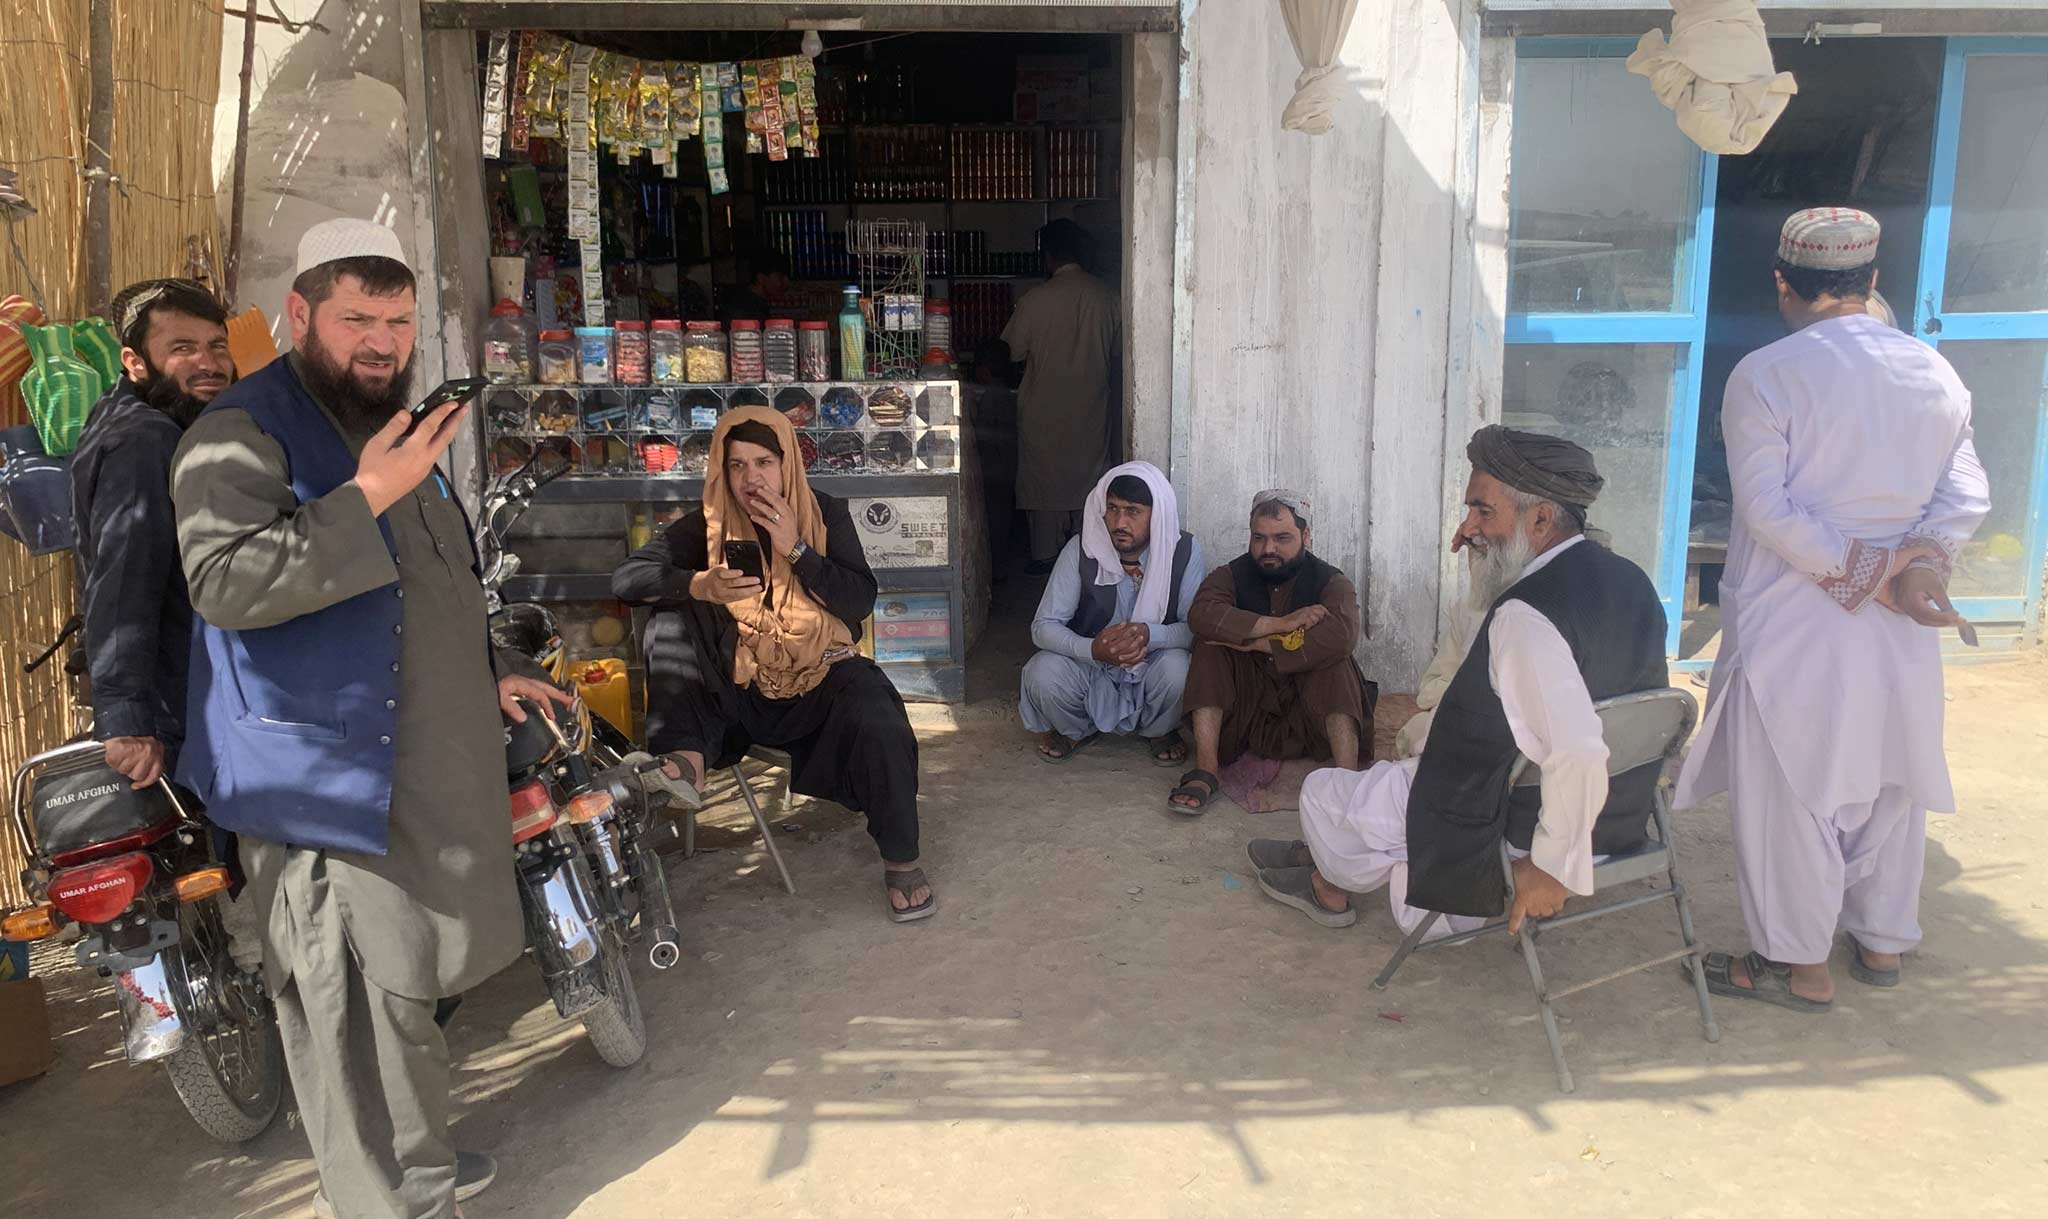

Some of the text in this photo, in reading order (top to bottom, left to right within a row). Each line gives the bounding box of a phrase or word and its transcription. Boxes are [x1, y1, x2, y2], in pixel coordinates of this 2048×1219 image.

[901, 523, 946, 532] SWEET
[46, 783, 120, 809] UMAR AFGHAN
[60, 877, 126, 899] UMAR AFGHAN
